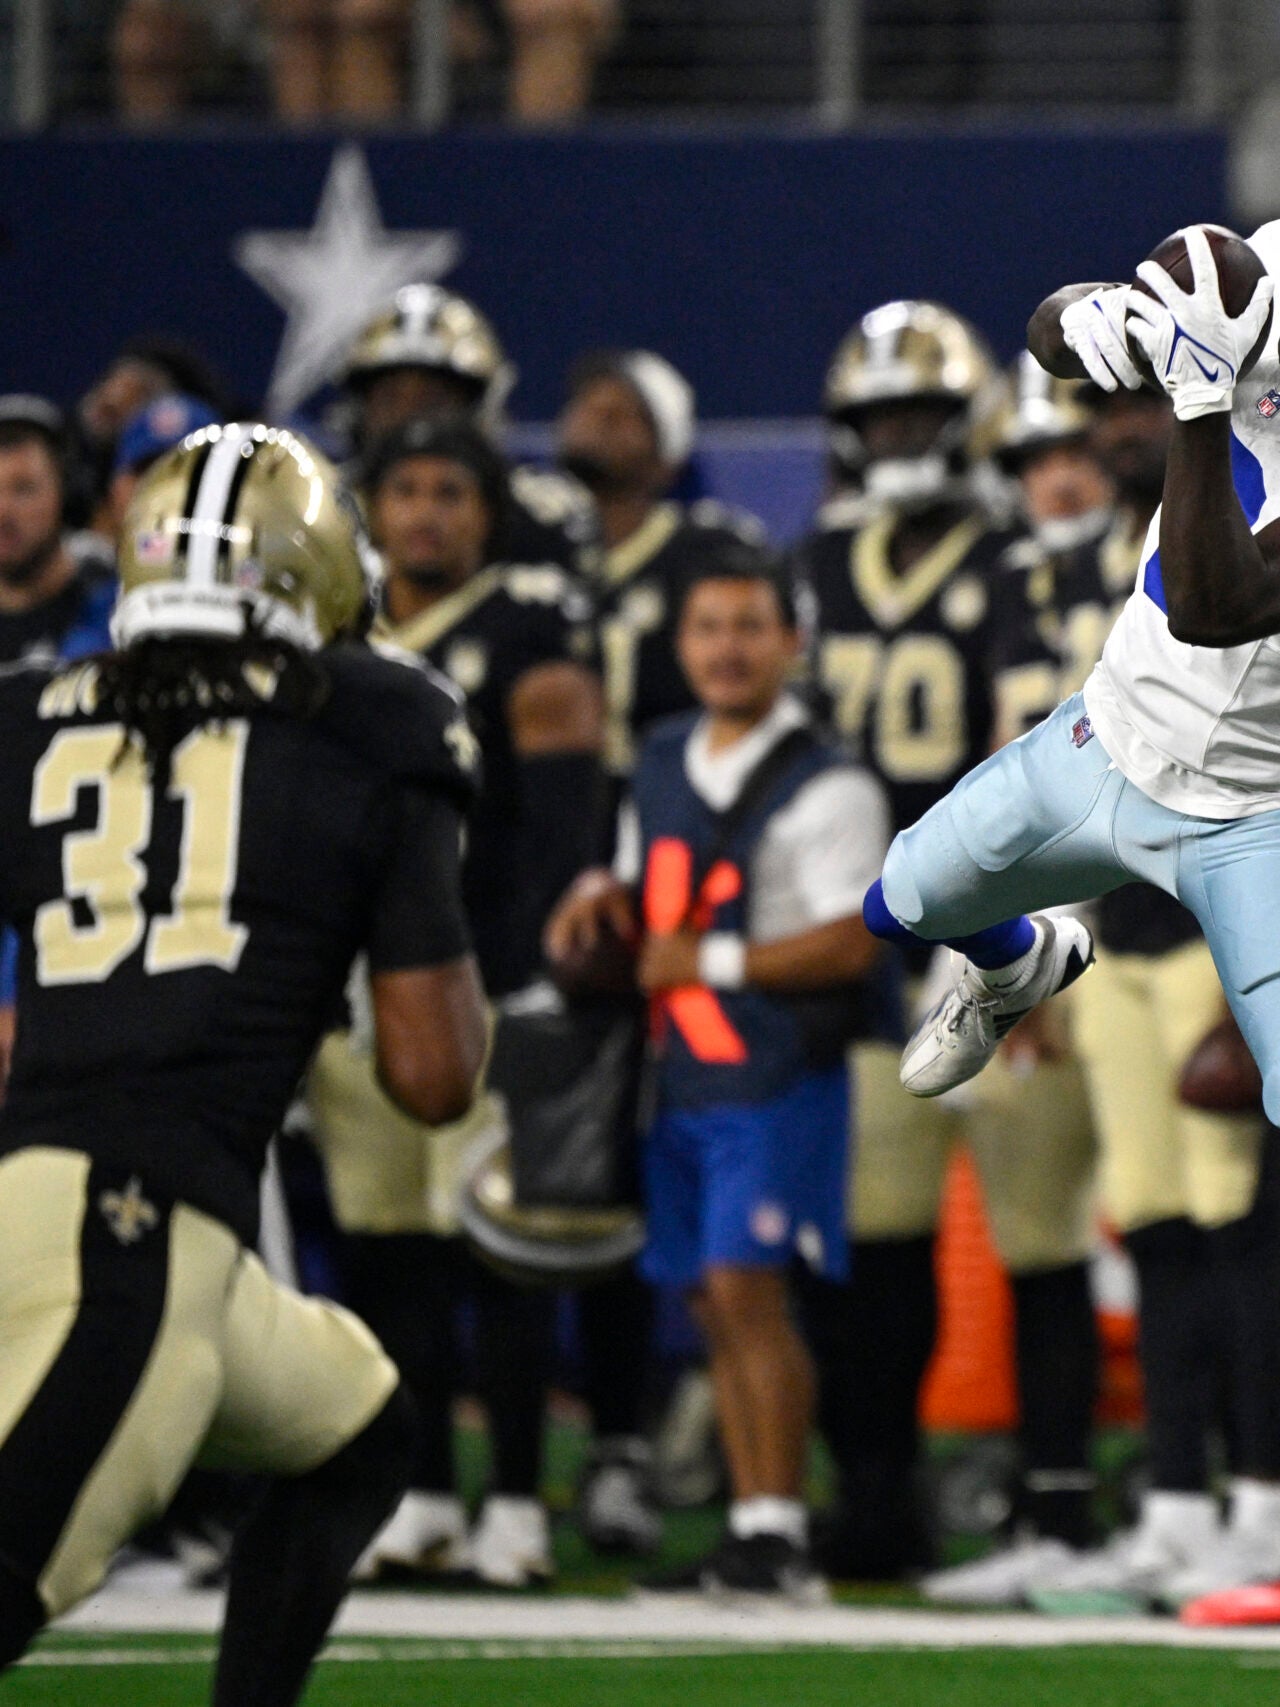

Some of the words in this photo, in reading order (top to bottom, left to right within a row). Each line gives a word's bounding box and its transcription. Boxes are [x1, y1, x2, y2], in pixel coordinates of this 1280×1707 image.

[1259, 396, 1277, 417] NFL
[820, 631, 968, 784] 70
[30, 718, 250, 987] 31
